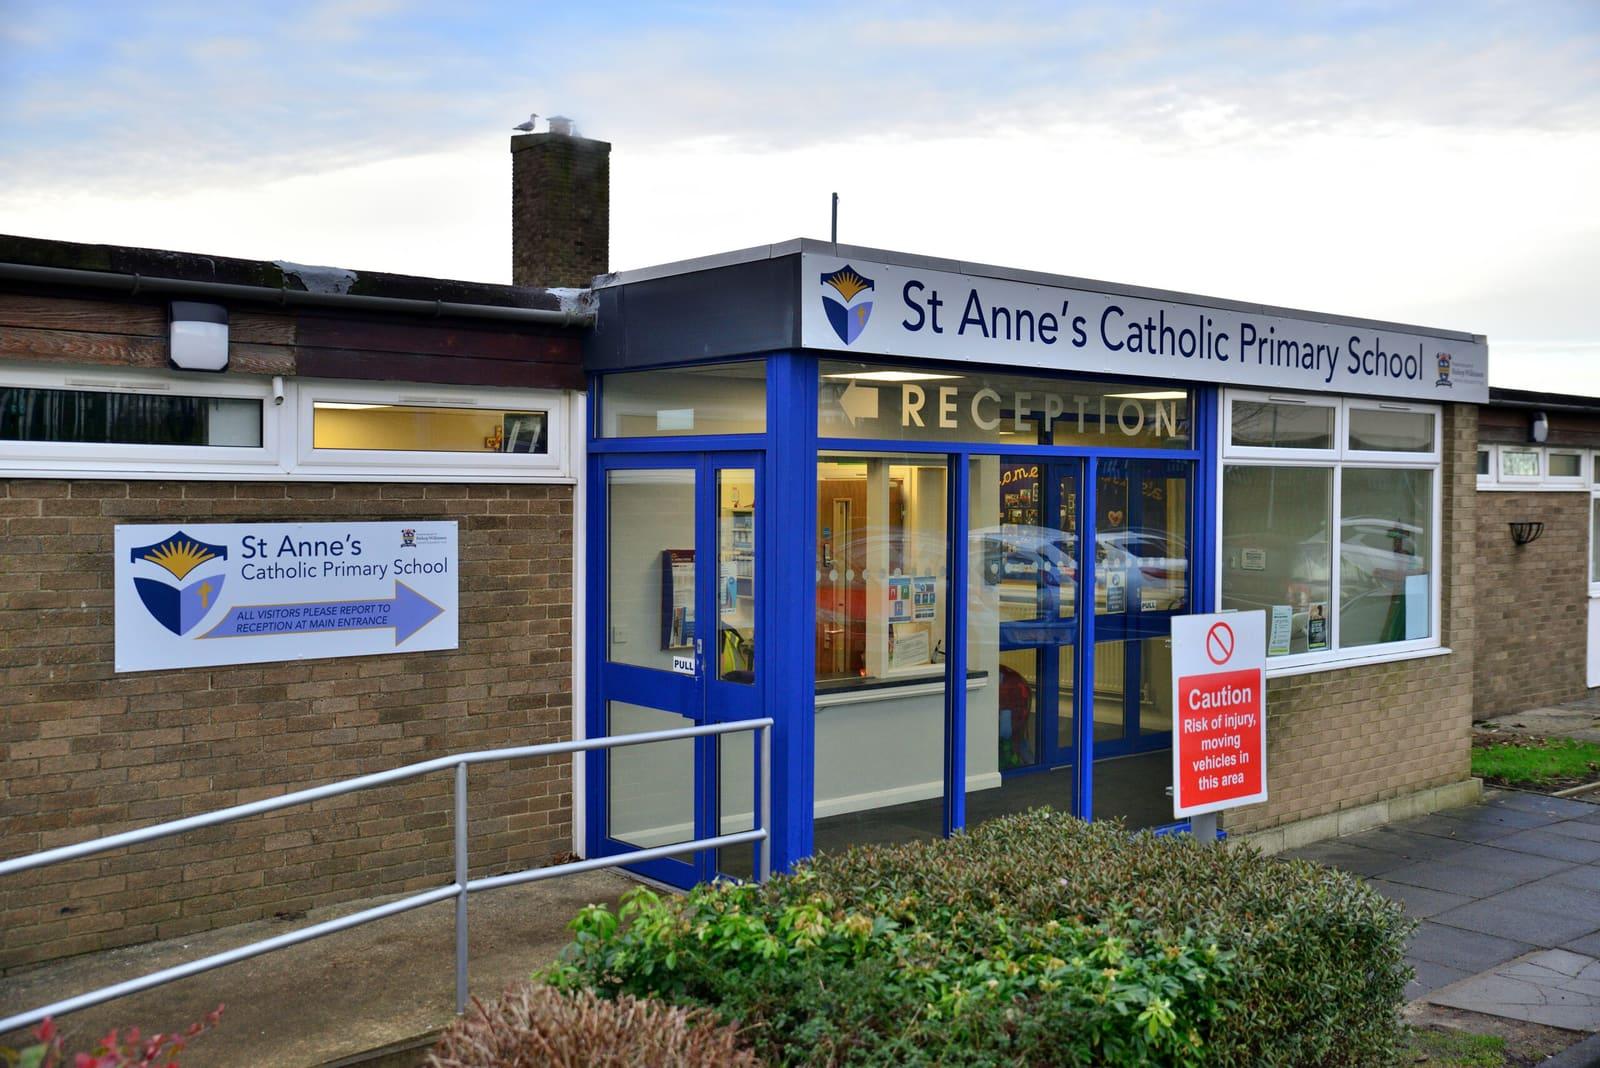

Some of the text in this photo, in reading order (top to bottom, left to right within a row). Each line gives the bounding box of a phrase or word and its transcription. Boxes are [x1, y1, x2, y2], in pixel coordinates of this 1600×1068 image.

[902, 280, 943, 334] St
[958, 289, 1087, 348] Anne's
[1100, 305, 1229, 361] Catholic
[1240, 323, 1339, 383] Primary
[1347, 336, 1423, 380] School
[902, 384, 1176, 438] RECEPTION
[241, 534, 362, 559] St Anne's
[241, 557, 448, 581] Catholic Primary School
[237, 604, 391, 620] ALL VISITORS PLEASE REPORT TO
[236, 615, 388, 633] RECEPTION AT MAIN ENTRANCE
[674, 660, 693, 671] PULL
[1189, 685, 1251, 710] Caution
[1184, 713, 1256, 734] Risk of injury,
[1201, 734, 1240, 751] moving
[1192, 751, 1249, 772] vehicles in
[1198, 772, 1244, 791] this area
